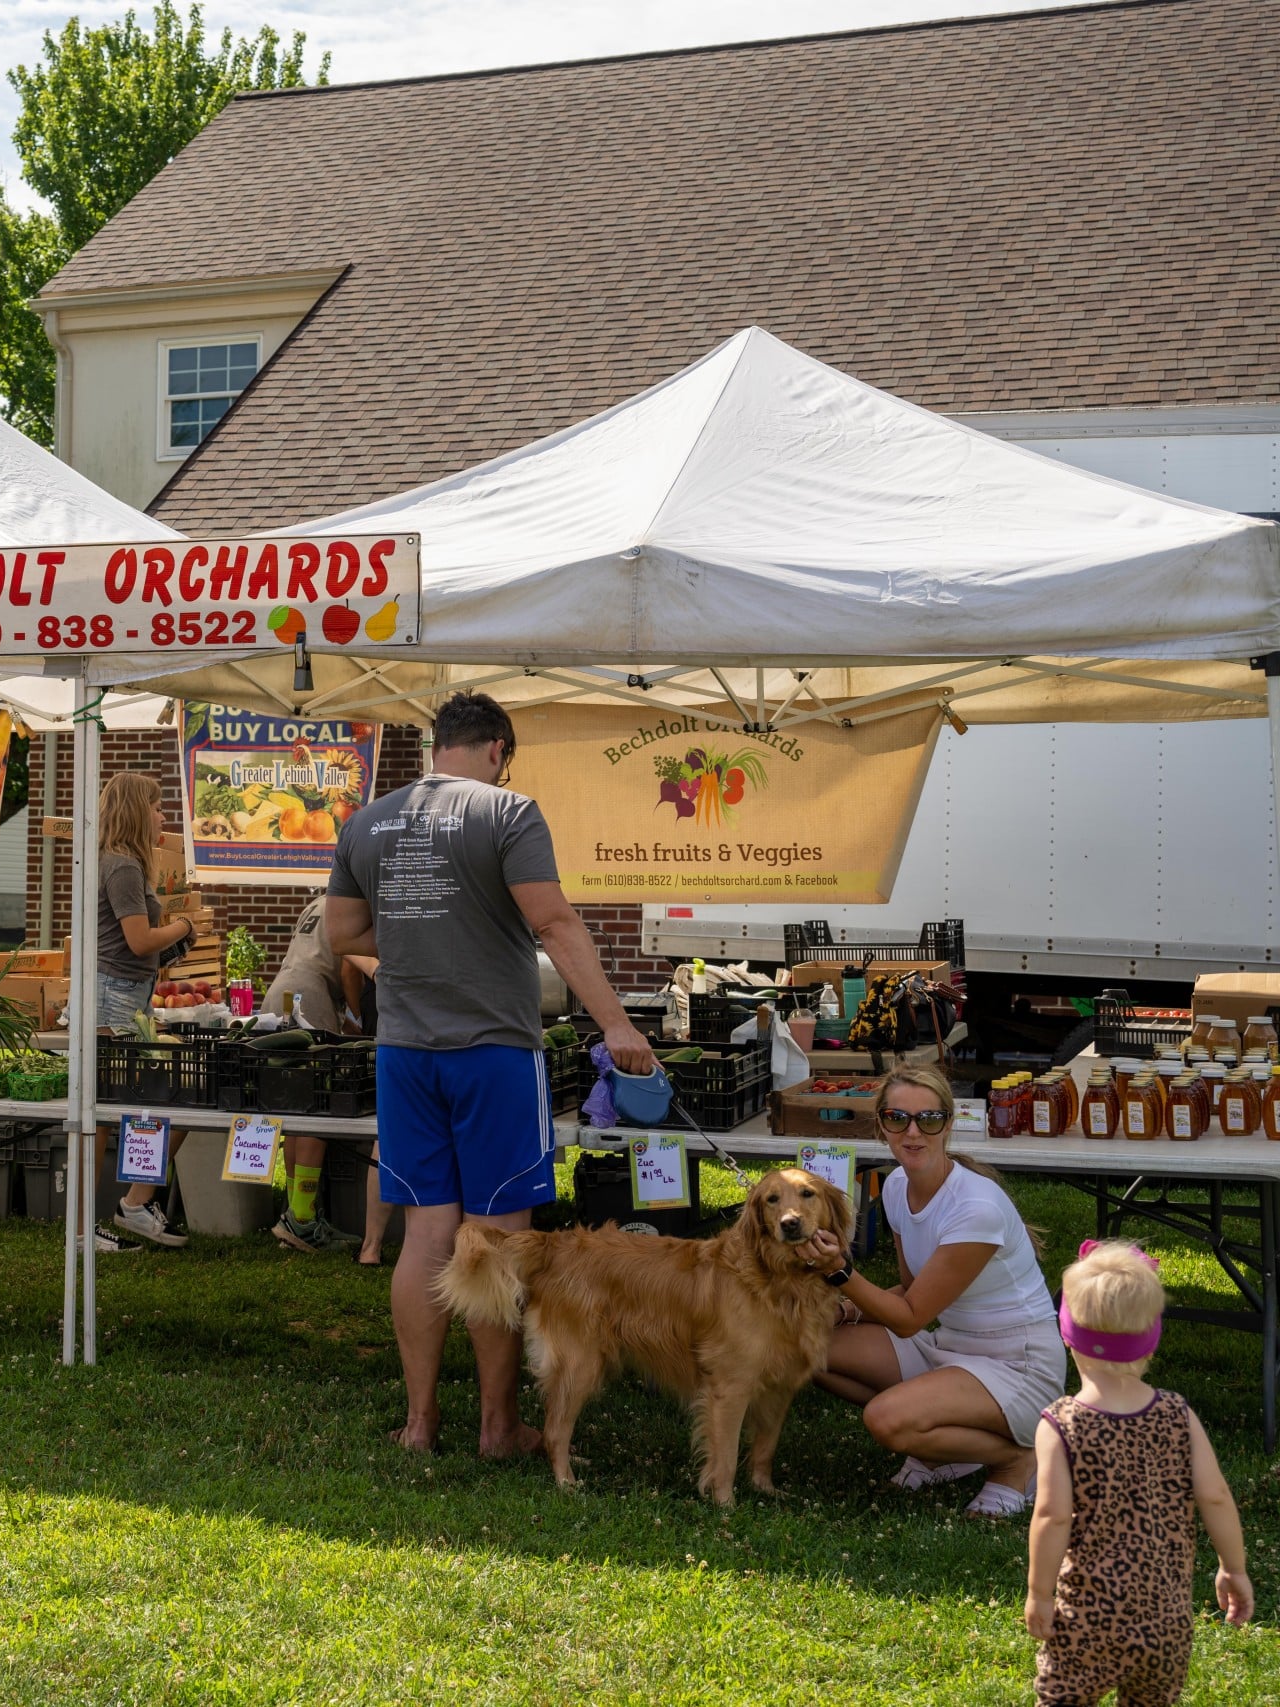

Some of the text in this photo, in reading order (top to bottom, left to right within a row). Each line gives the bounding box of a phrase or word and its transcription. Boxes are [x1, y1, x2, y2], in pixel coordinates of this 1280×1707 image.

[104, 539, 396, 606] ORCHARDS
[37, 614, 115, 649] 838
[150, 610, 257, 646] 8522
[209, 723, 262, 742] BUY
[603, 715, 804, 765] Bechdolt Orards
[231, 760, 348, 789] Greater Lehigh Valley
[595, 842, 823, 867] fresh fruits & Veggies
[582, 875, 602, 886] farm
[604, 874, 672, 887] (610)838-8522
[681, 874, 782, 887] bechdoltsorchard.com
[784, 875, 793, 886] &
[795, 874, 838, 886] Facebook
[125, 1134, 150, 1148] Candy
[234, 1136, 272, 1150] Cucumber
[128, 1146, 154, 1156] Onions
[637, 1158, 654, 1166] Zuc
